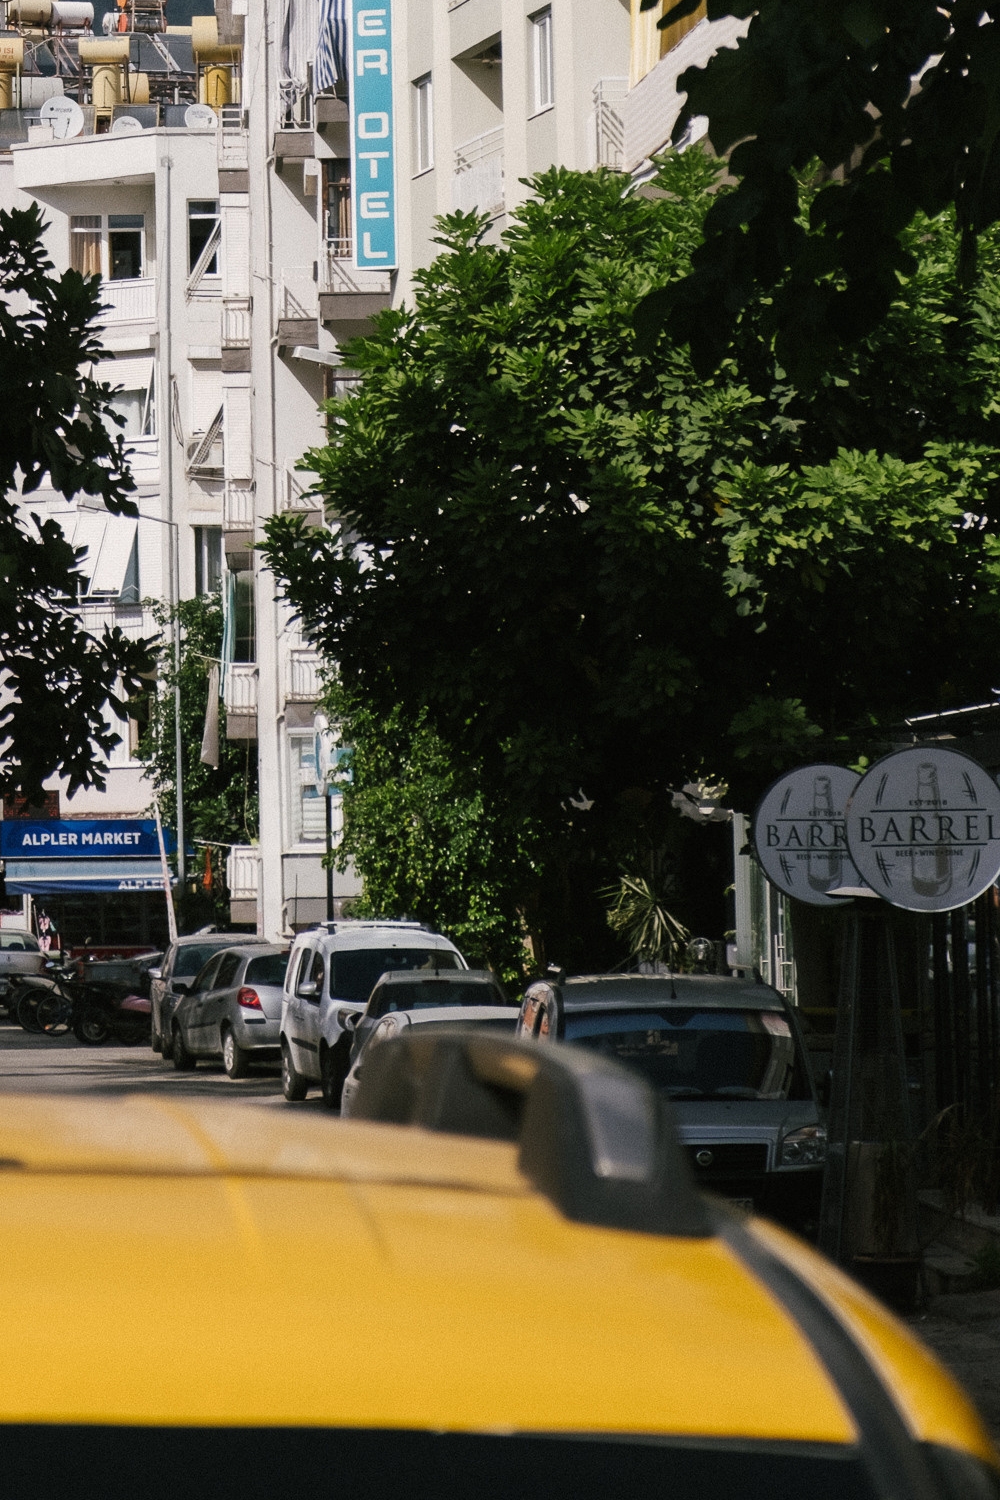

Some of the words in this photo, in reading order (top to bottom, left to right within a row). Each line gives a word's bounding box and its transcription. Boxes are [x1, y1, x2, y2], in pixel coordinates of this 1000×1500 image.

[357, 111, 390, 259] OTEL
[22, 833, 78, 846] ALPLER
[81, 832, 141, 845] MARKET
[766, 824, 848, 847] BARR
[895, 849, 913, 858] BEER
